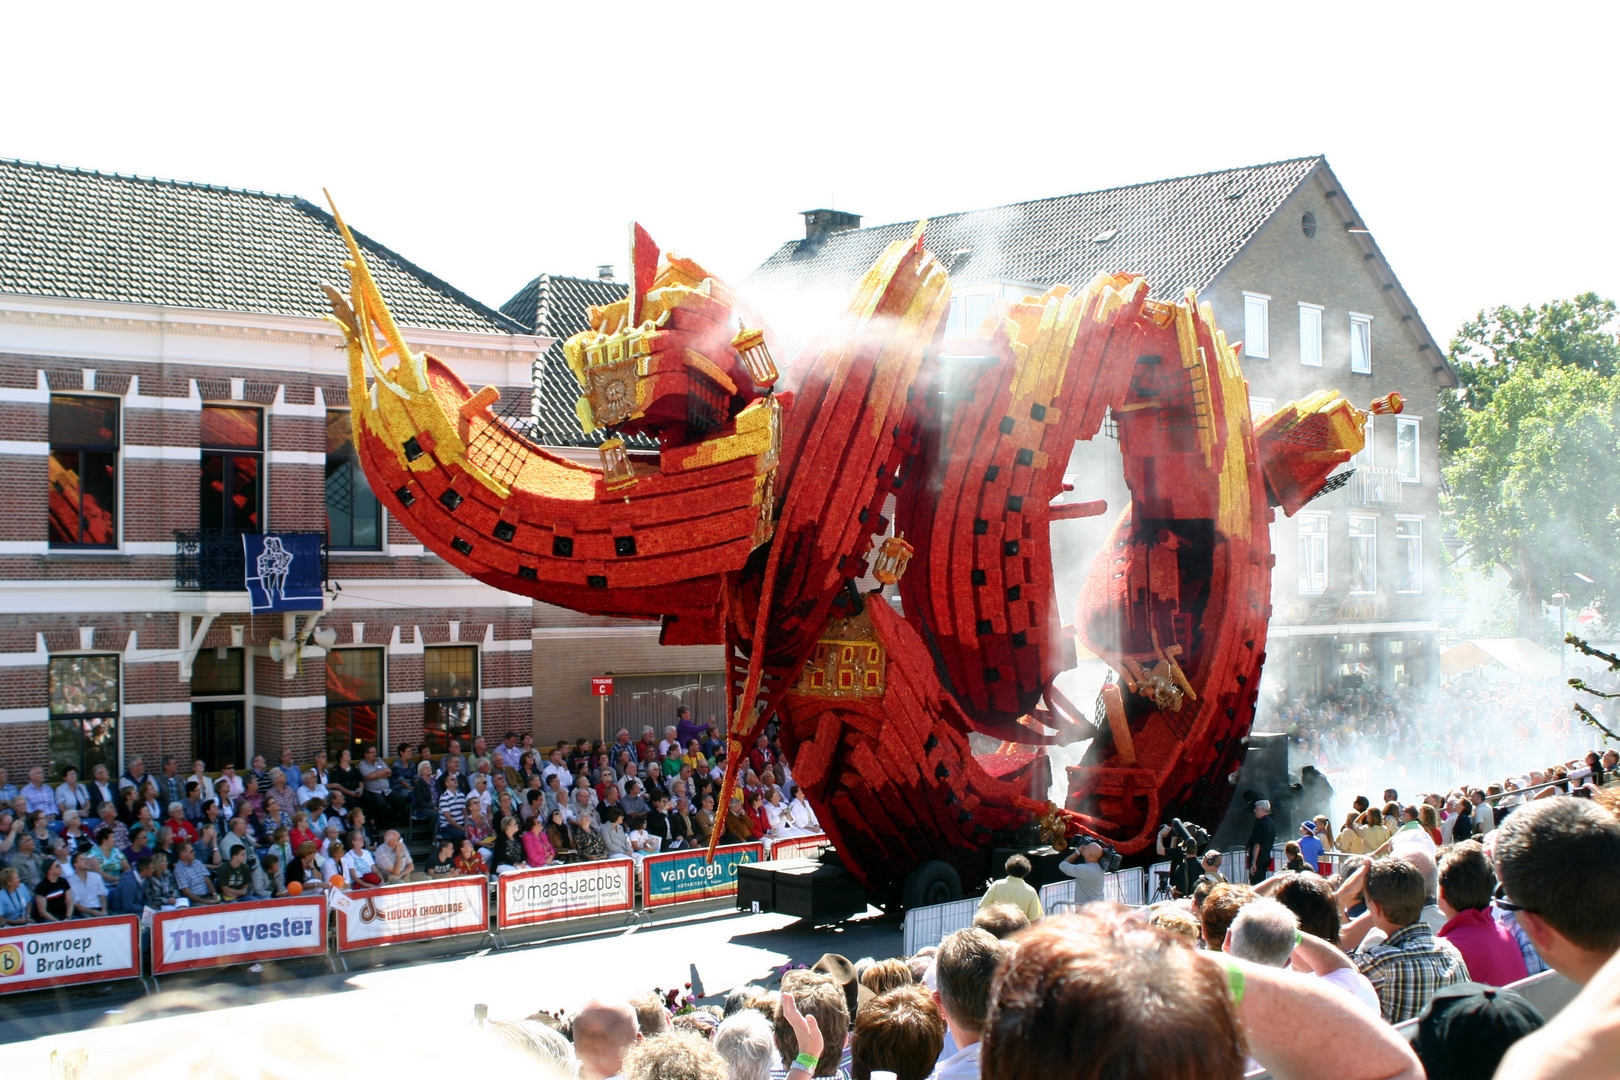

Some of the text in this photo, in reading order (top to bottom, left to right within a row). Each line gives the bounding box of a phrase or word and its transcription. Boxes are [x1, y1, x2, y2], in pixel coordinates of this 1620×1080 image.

[599, 685, 606, 694] C
[661, 861, 722, 882] van Gogh
[419, 902, 463, 916] CHOCOLADE
[169, 917, 313, 951] Thuisvester
[26, 937, 92, 955] Omroep
[36, 953, 103, 973] Brabant
